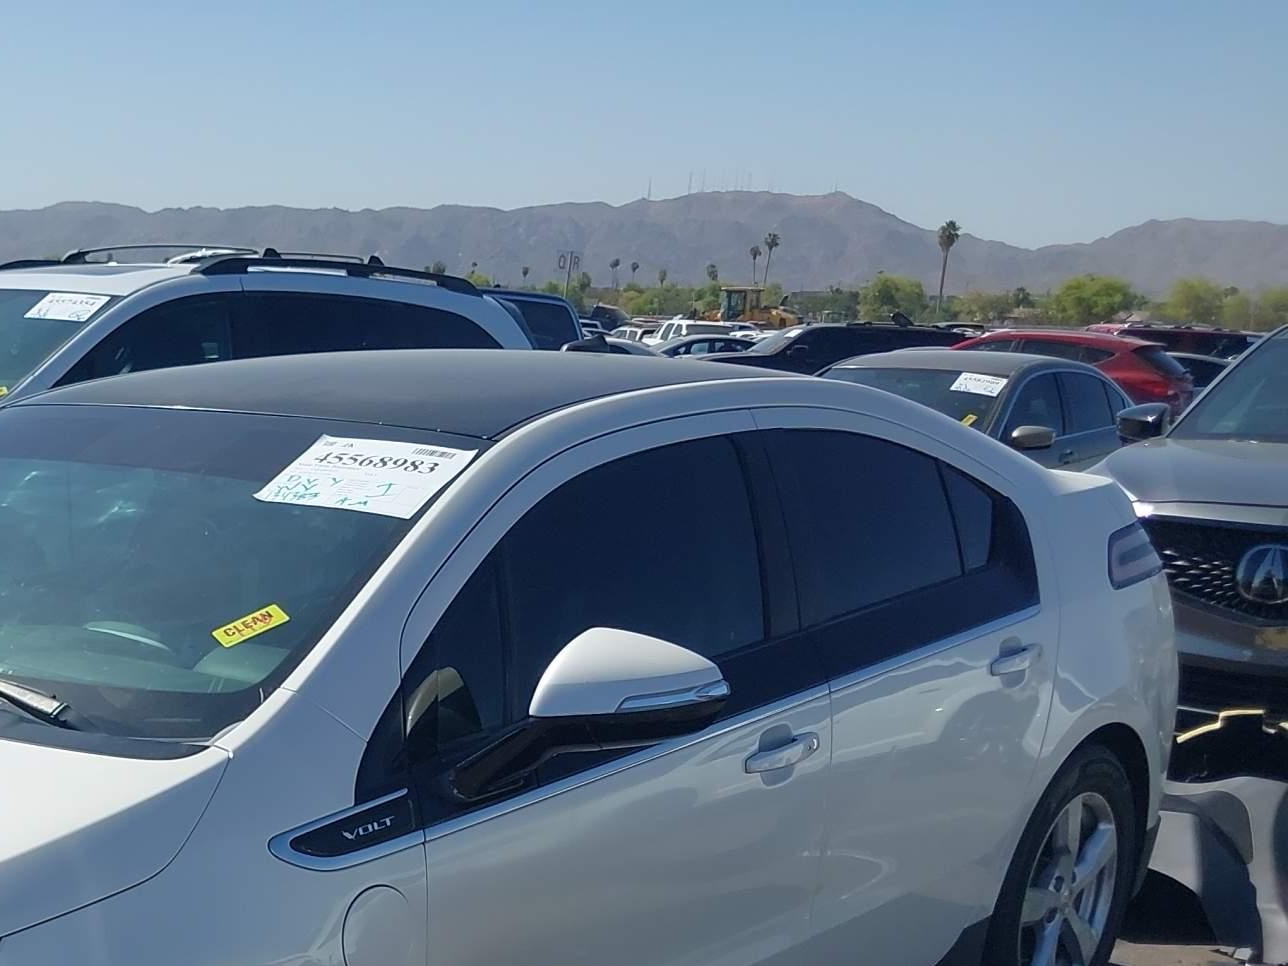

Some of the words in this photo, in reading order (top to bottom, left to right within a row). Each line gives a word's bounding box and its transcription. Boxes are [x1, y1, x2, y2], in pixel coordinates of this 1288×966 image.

[314, 451, 440, 475] 45568983
[223, 610, 274, 637] CLEAN
[340, 815, 395, 840] VOLT
